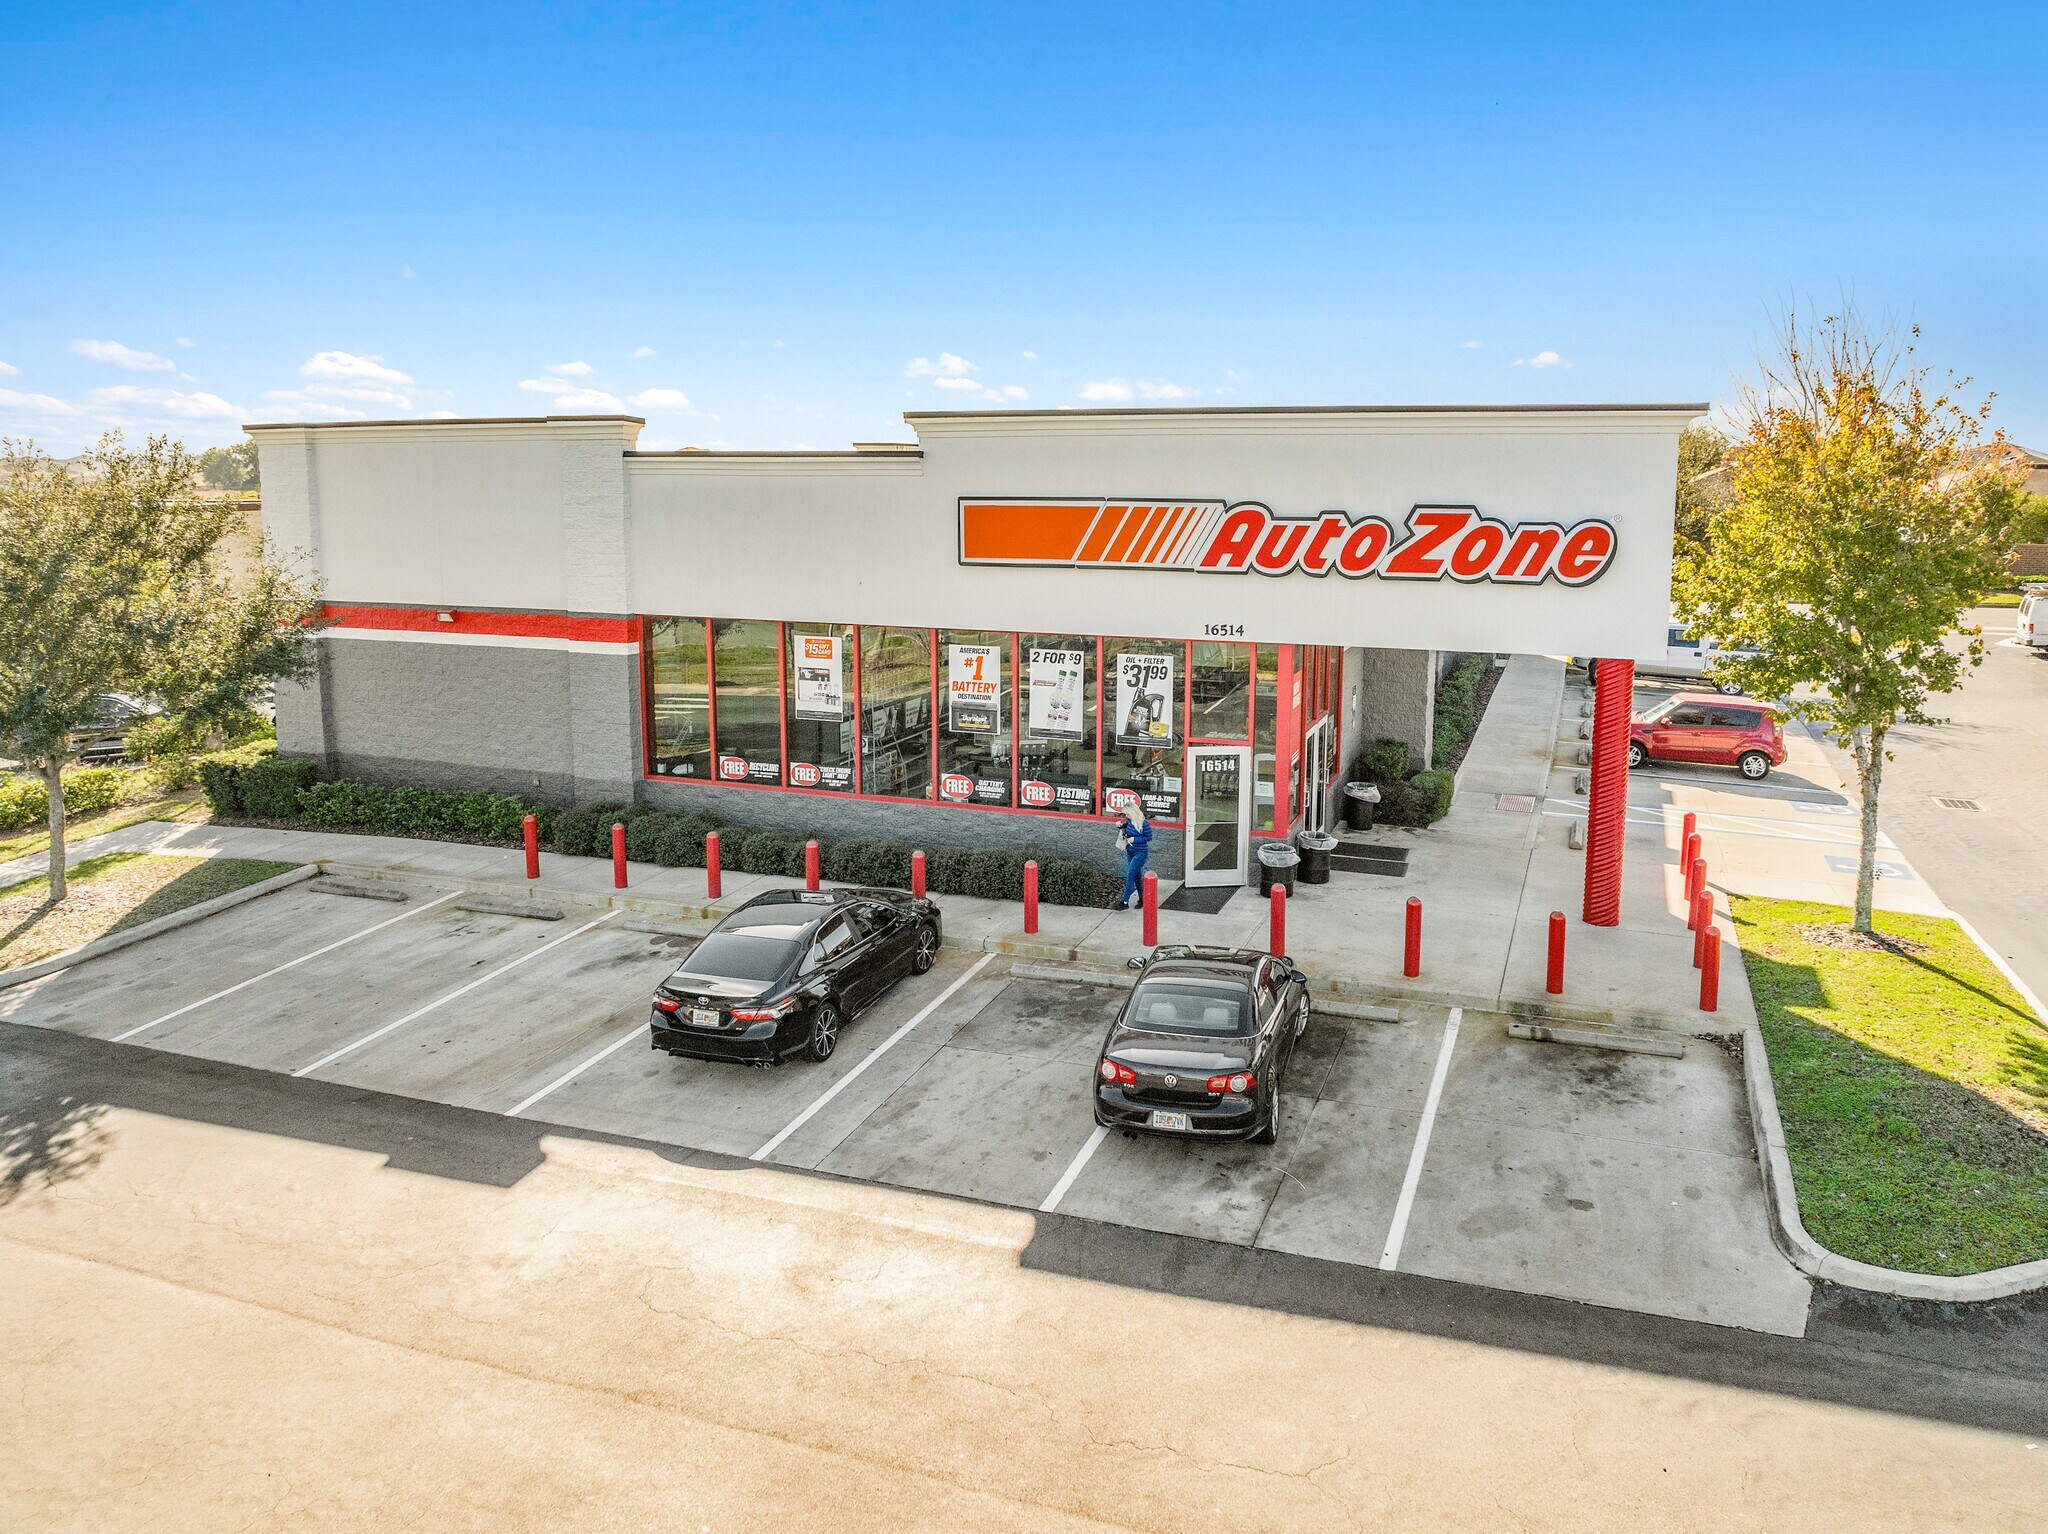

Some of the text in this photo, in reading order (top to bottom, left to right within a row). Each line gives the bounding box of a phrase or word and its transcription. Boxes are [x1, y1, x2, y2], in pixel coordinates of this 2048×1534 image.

[1199, 508, 1615, 579] AutoZone
[1204, 624, 1245, 637] 16514
[805, 643, 819, 654] $15
[959, 647, 990, 655] AMERICA'S
[1032, 651, 1082, 665] 2 FOR $9
[1125, 656, 1136, 664] OIL
[1143, 657, 1165, 665] FILTER
[964, 655, 984, 681] #1
[951, 680, 997, 694] BATTERY
[957, 692, 992, 701] DESTINATION
[723, 761, 745, 776] FREE
[749, 762, 780, 773] RECYCLING
[1200, 759, 1236, 772] 16514
[794, 767, 817, 782] FREE
[945, 778, 969, 794] FREE
[978, 779, 1004, 787] BATTERY
[1026, 785, 1051, 802] FREE
[1056, 787, 1090, 800] TESTING
